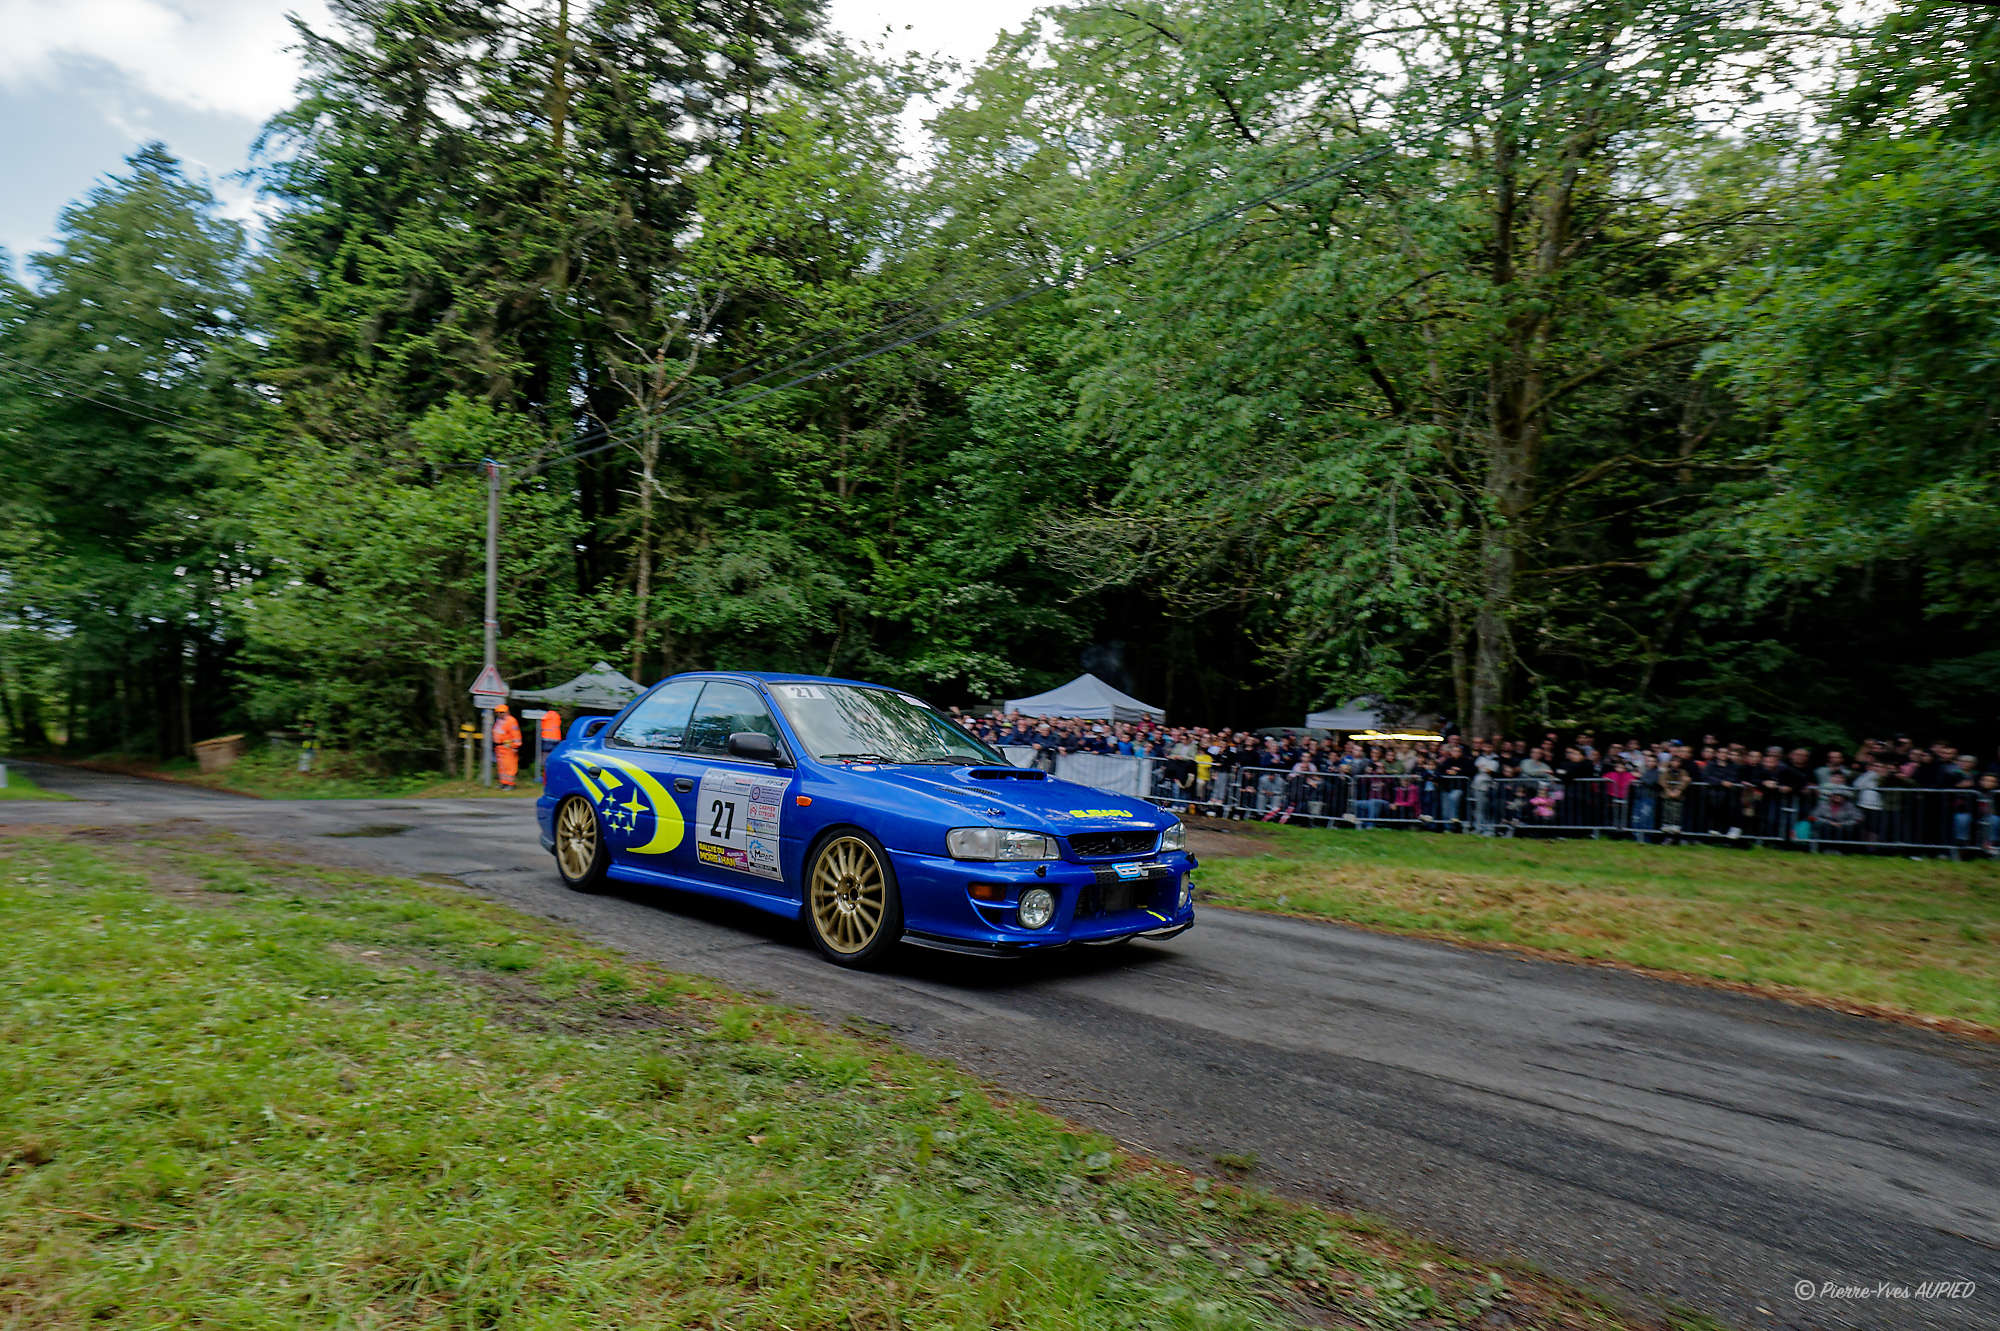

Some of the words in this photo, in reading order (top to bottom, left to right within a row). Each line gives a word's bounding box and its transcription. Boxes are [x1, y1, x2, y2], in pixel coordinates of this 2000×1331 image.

[791, 687, 815, 698] 27
[1069, 809, 1133, 818] SUBARU
[711, 800, 735, 840] 27
